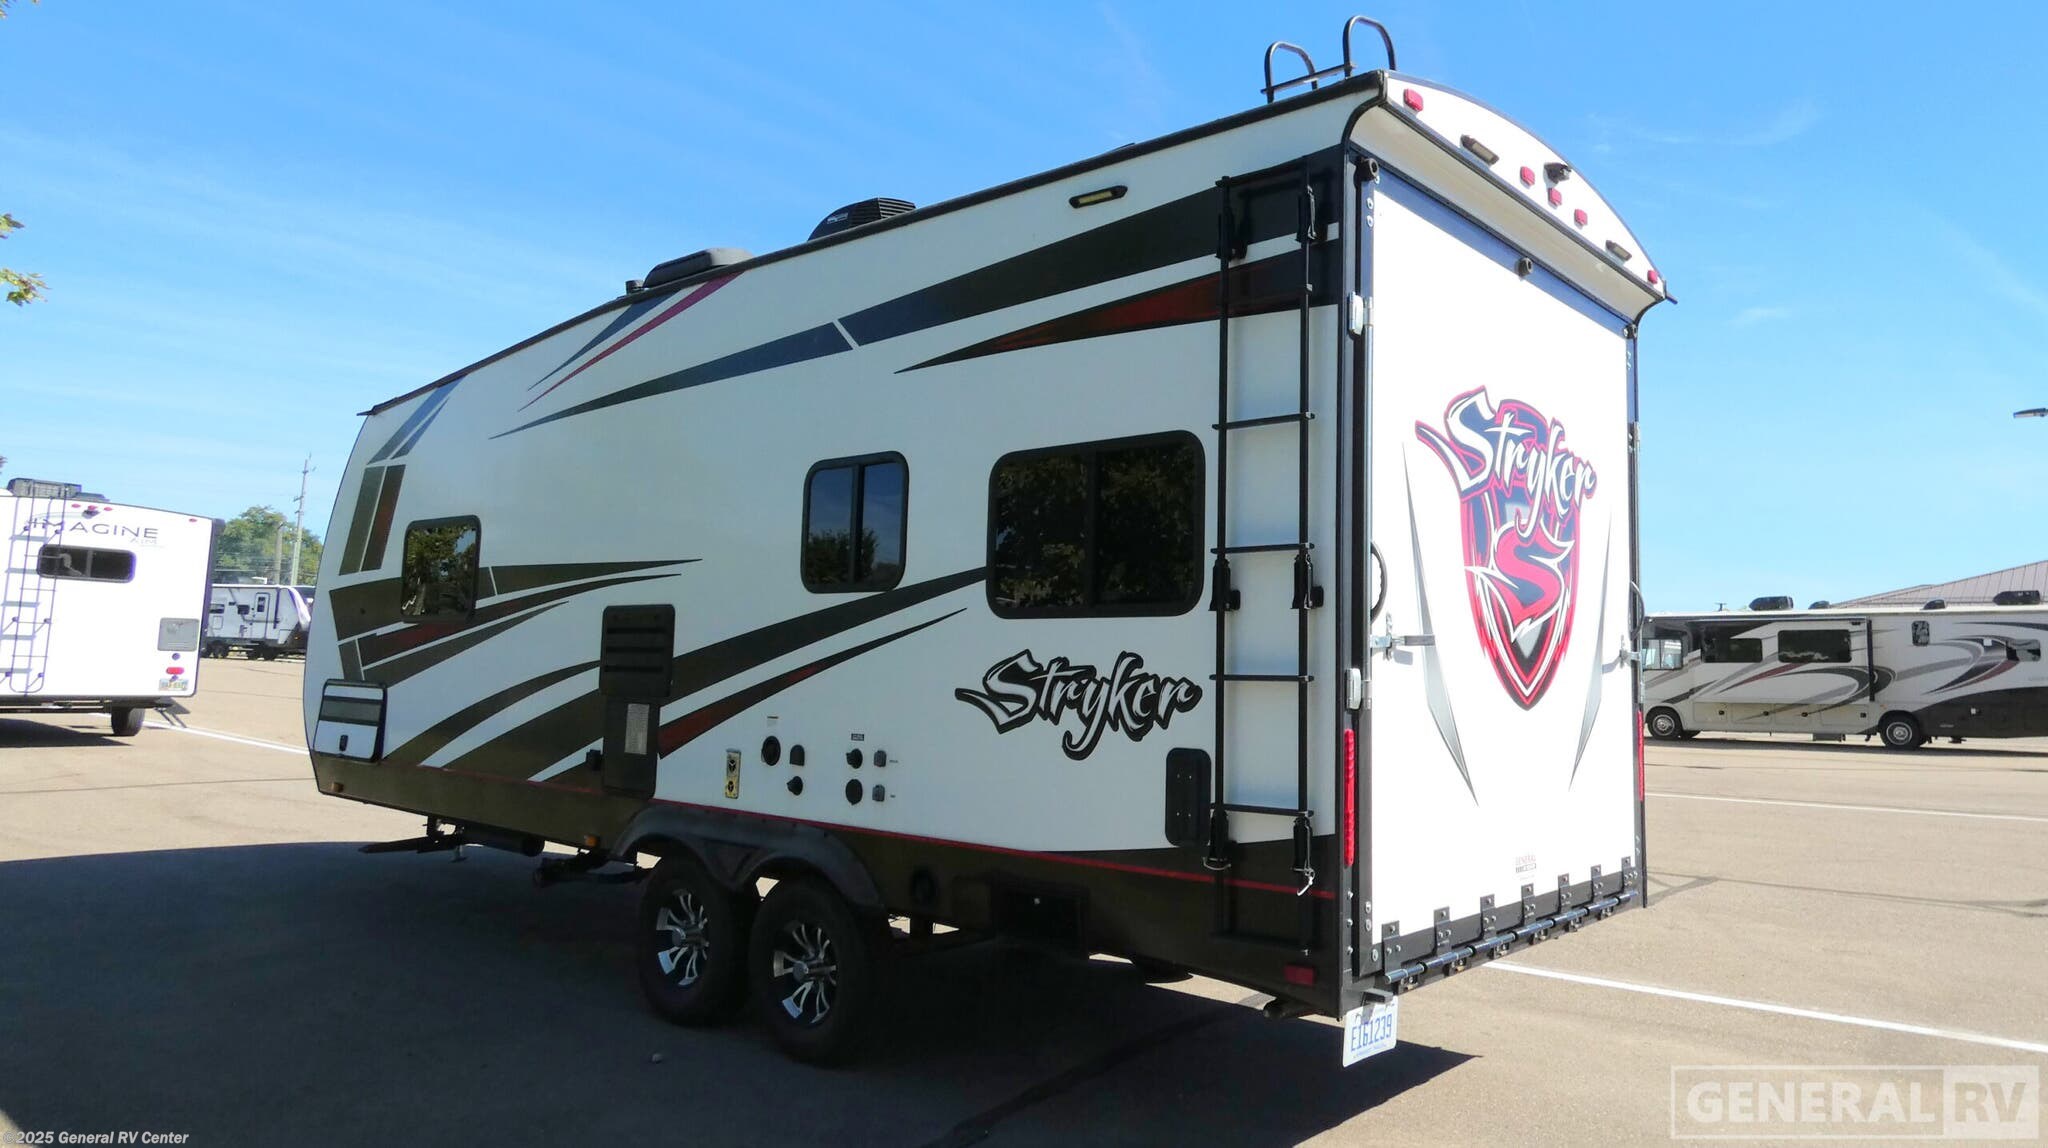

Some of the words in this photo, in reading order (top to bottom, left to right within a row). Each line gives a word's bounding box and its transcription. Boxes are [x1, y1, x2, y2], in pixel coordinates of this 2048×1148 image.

[1415, 384, 1597, 538] Stryker
[954, 648, 1203, 761] Stryker
[1351, 1012, 1393, 1051] E161239
